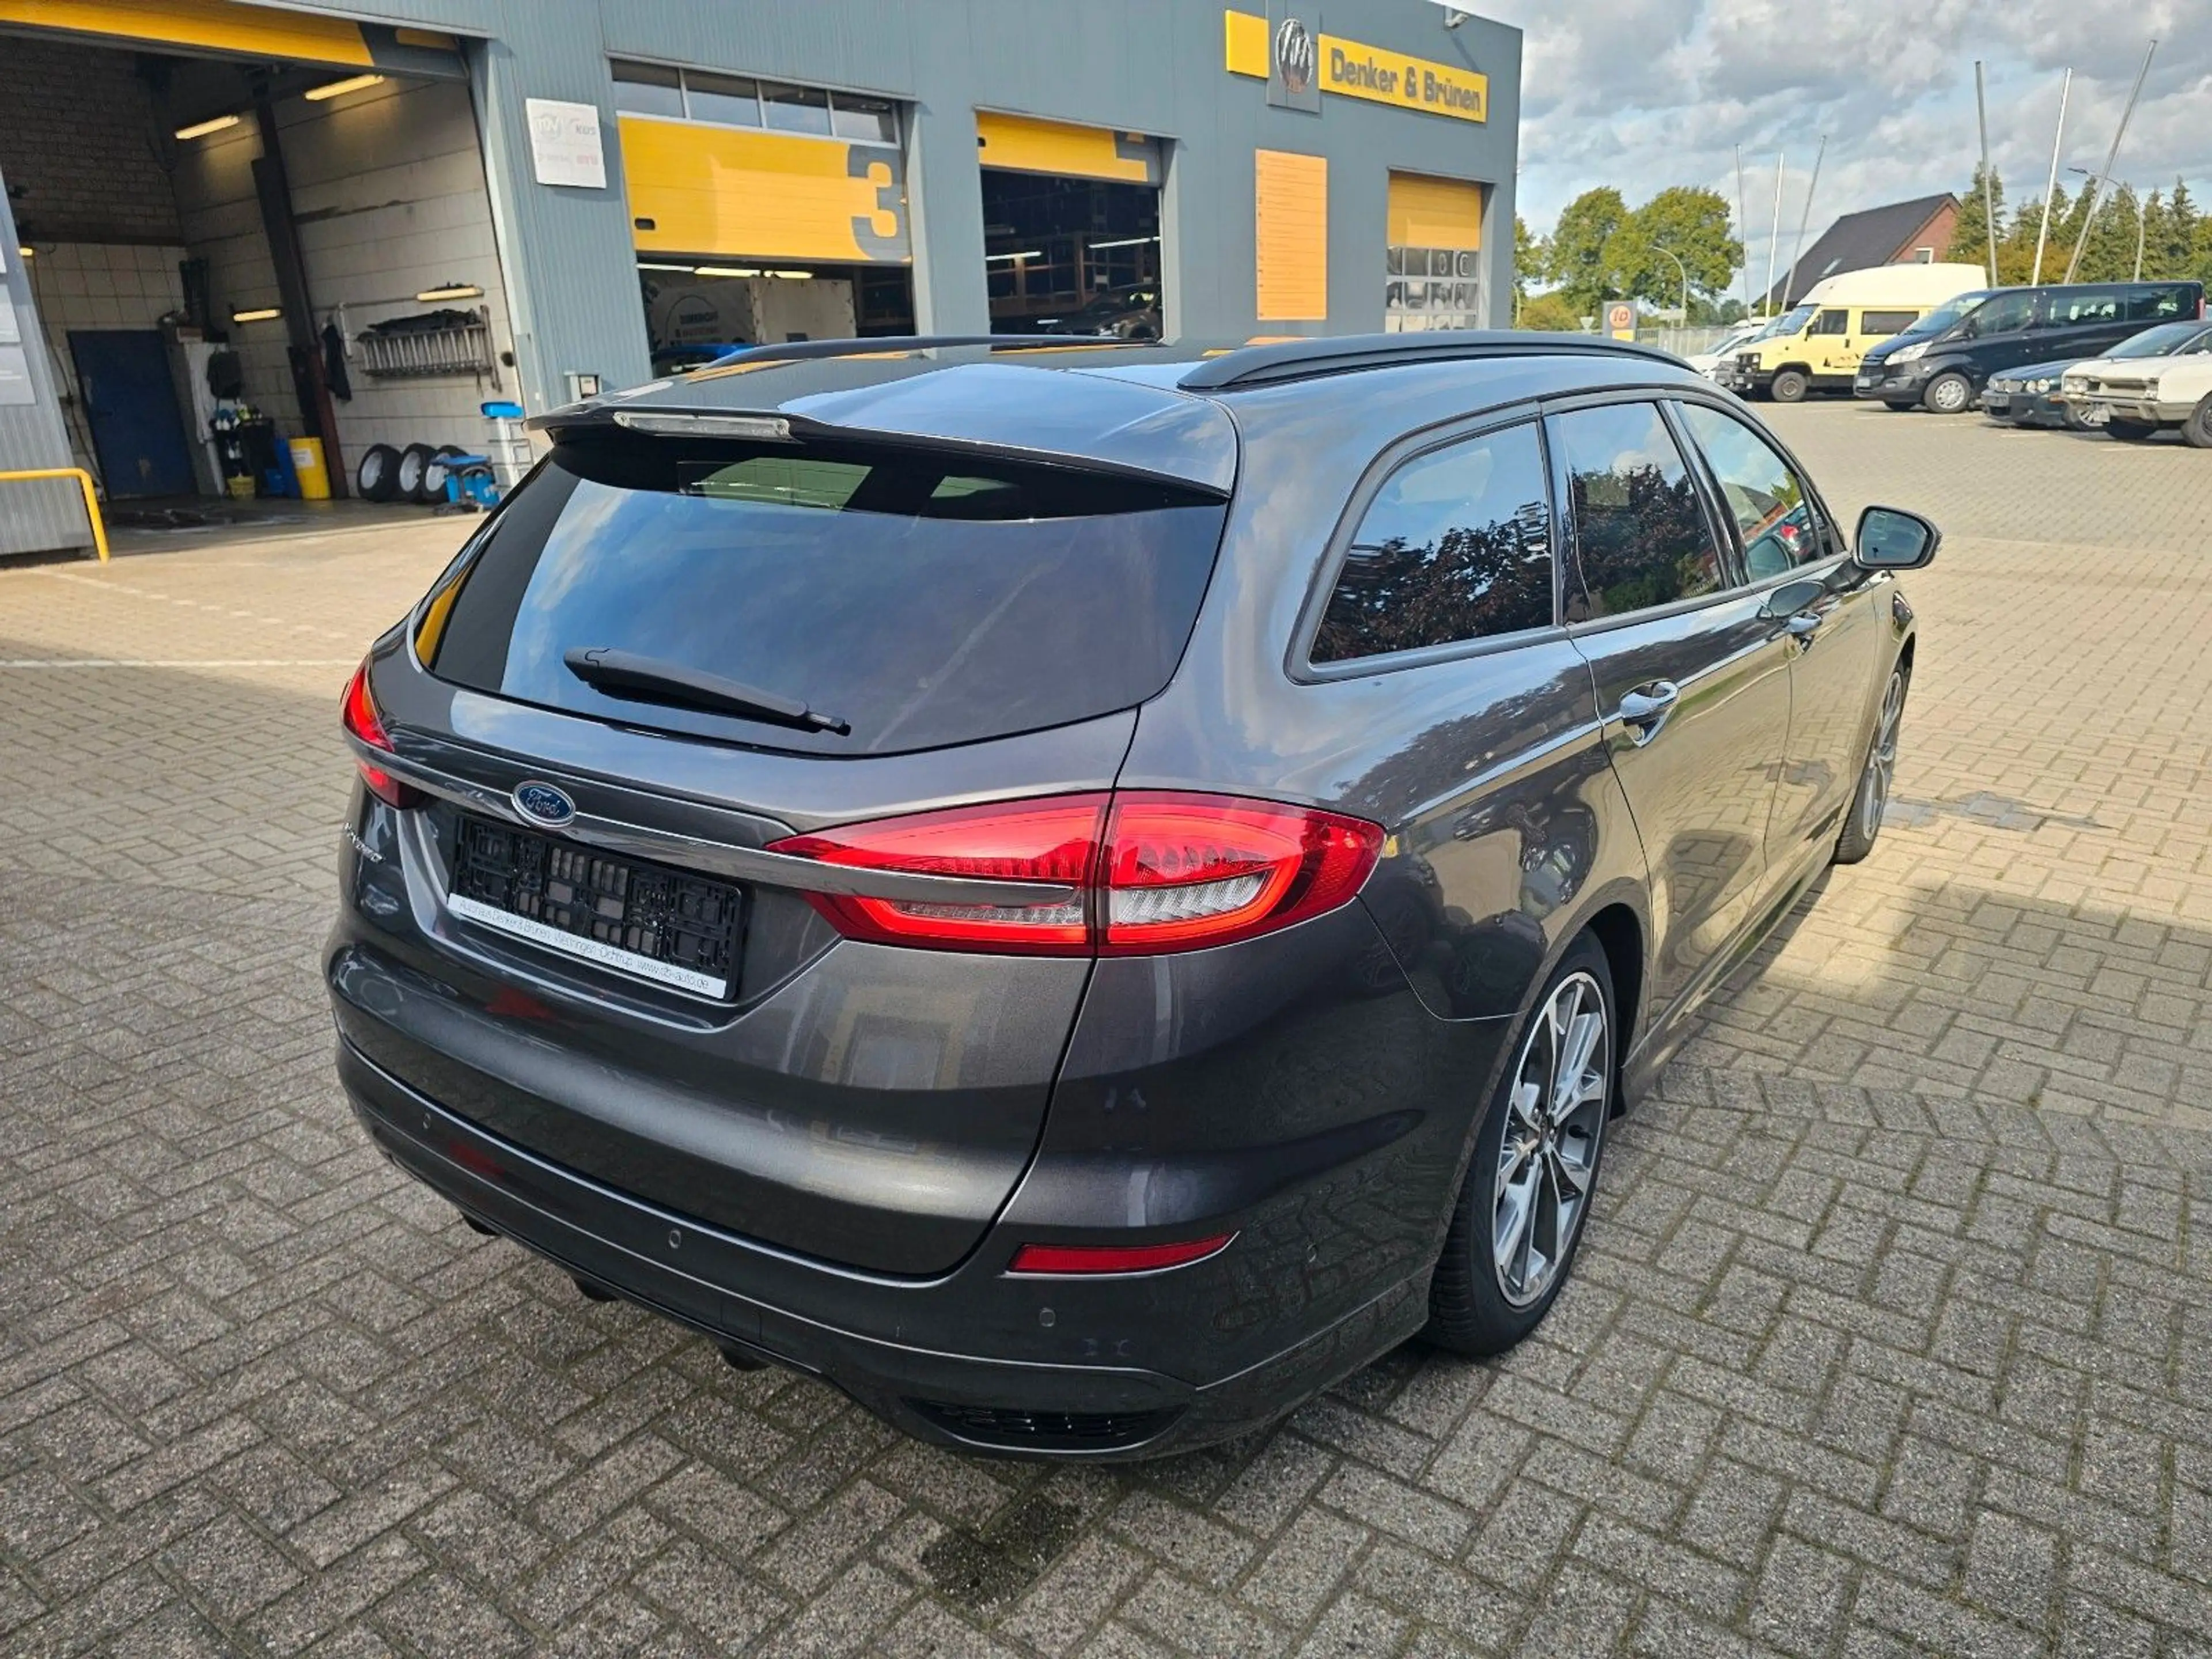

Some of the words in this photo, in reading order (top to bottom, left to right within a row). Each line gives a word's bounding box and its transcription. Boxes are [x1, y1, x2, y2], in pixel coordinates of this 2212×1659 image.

[1331, 47, 1398, 93] Denker
[1405, 66, 1416, 97] &
[1424, 70, 1480, 112] Brünen
[847, 144, 911, 260] 3
[525, 787, 560, 816] Ford
